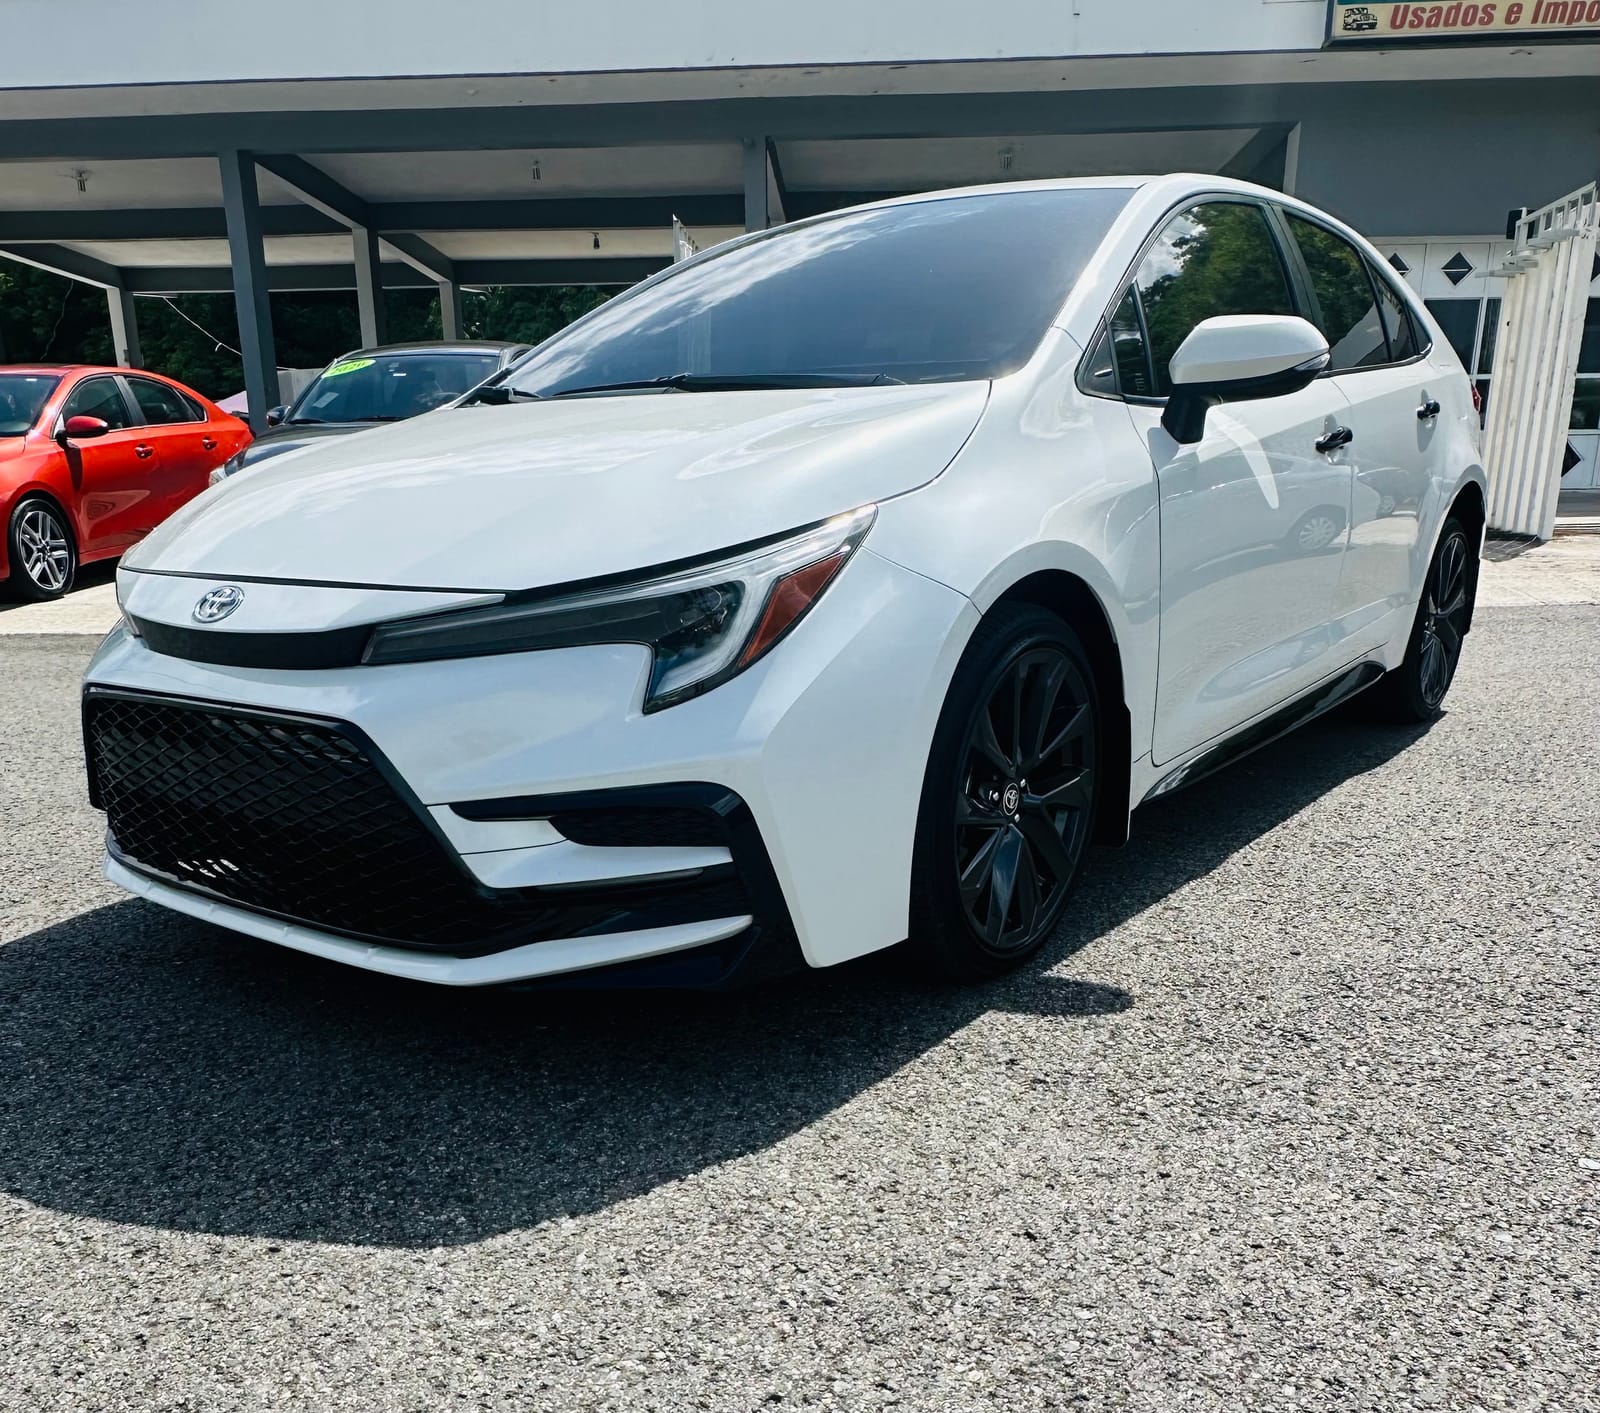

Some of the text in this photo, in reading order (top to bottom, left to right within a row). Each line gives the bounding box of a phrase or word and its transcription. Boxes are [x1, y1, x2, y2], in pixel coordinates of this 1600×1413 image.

[1390, 0, 1600, 30] Usados e Impo
